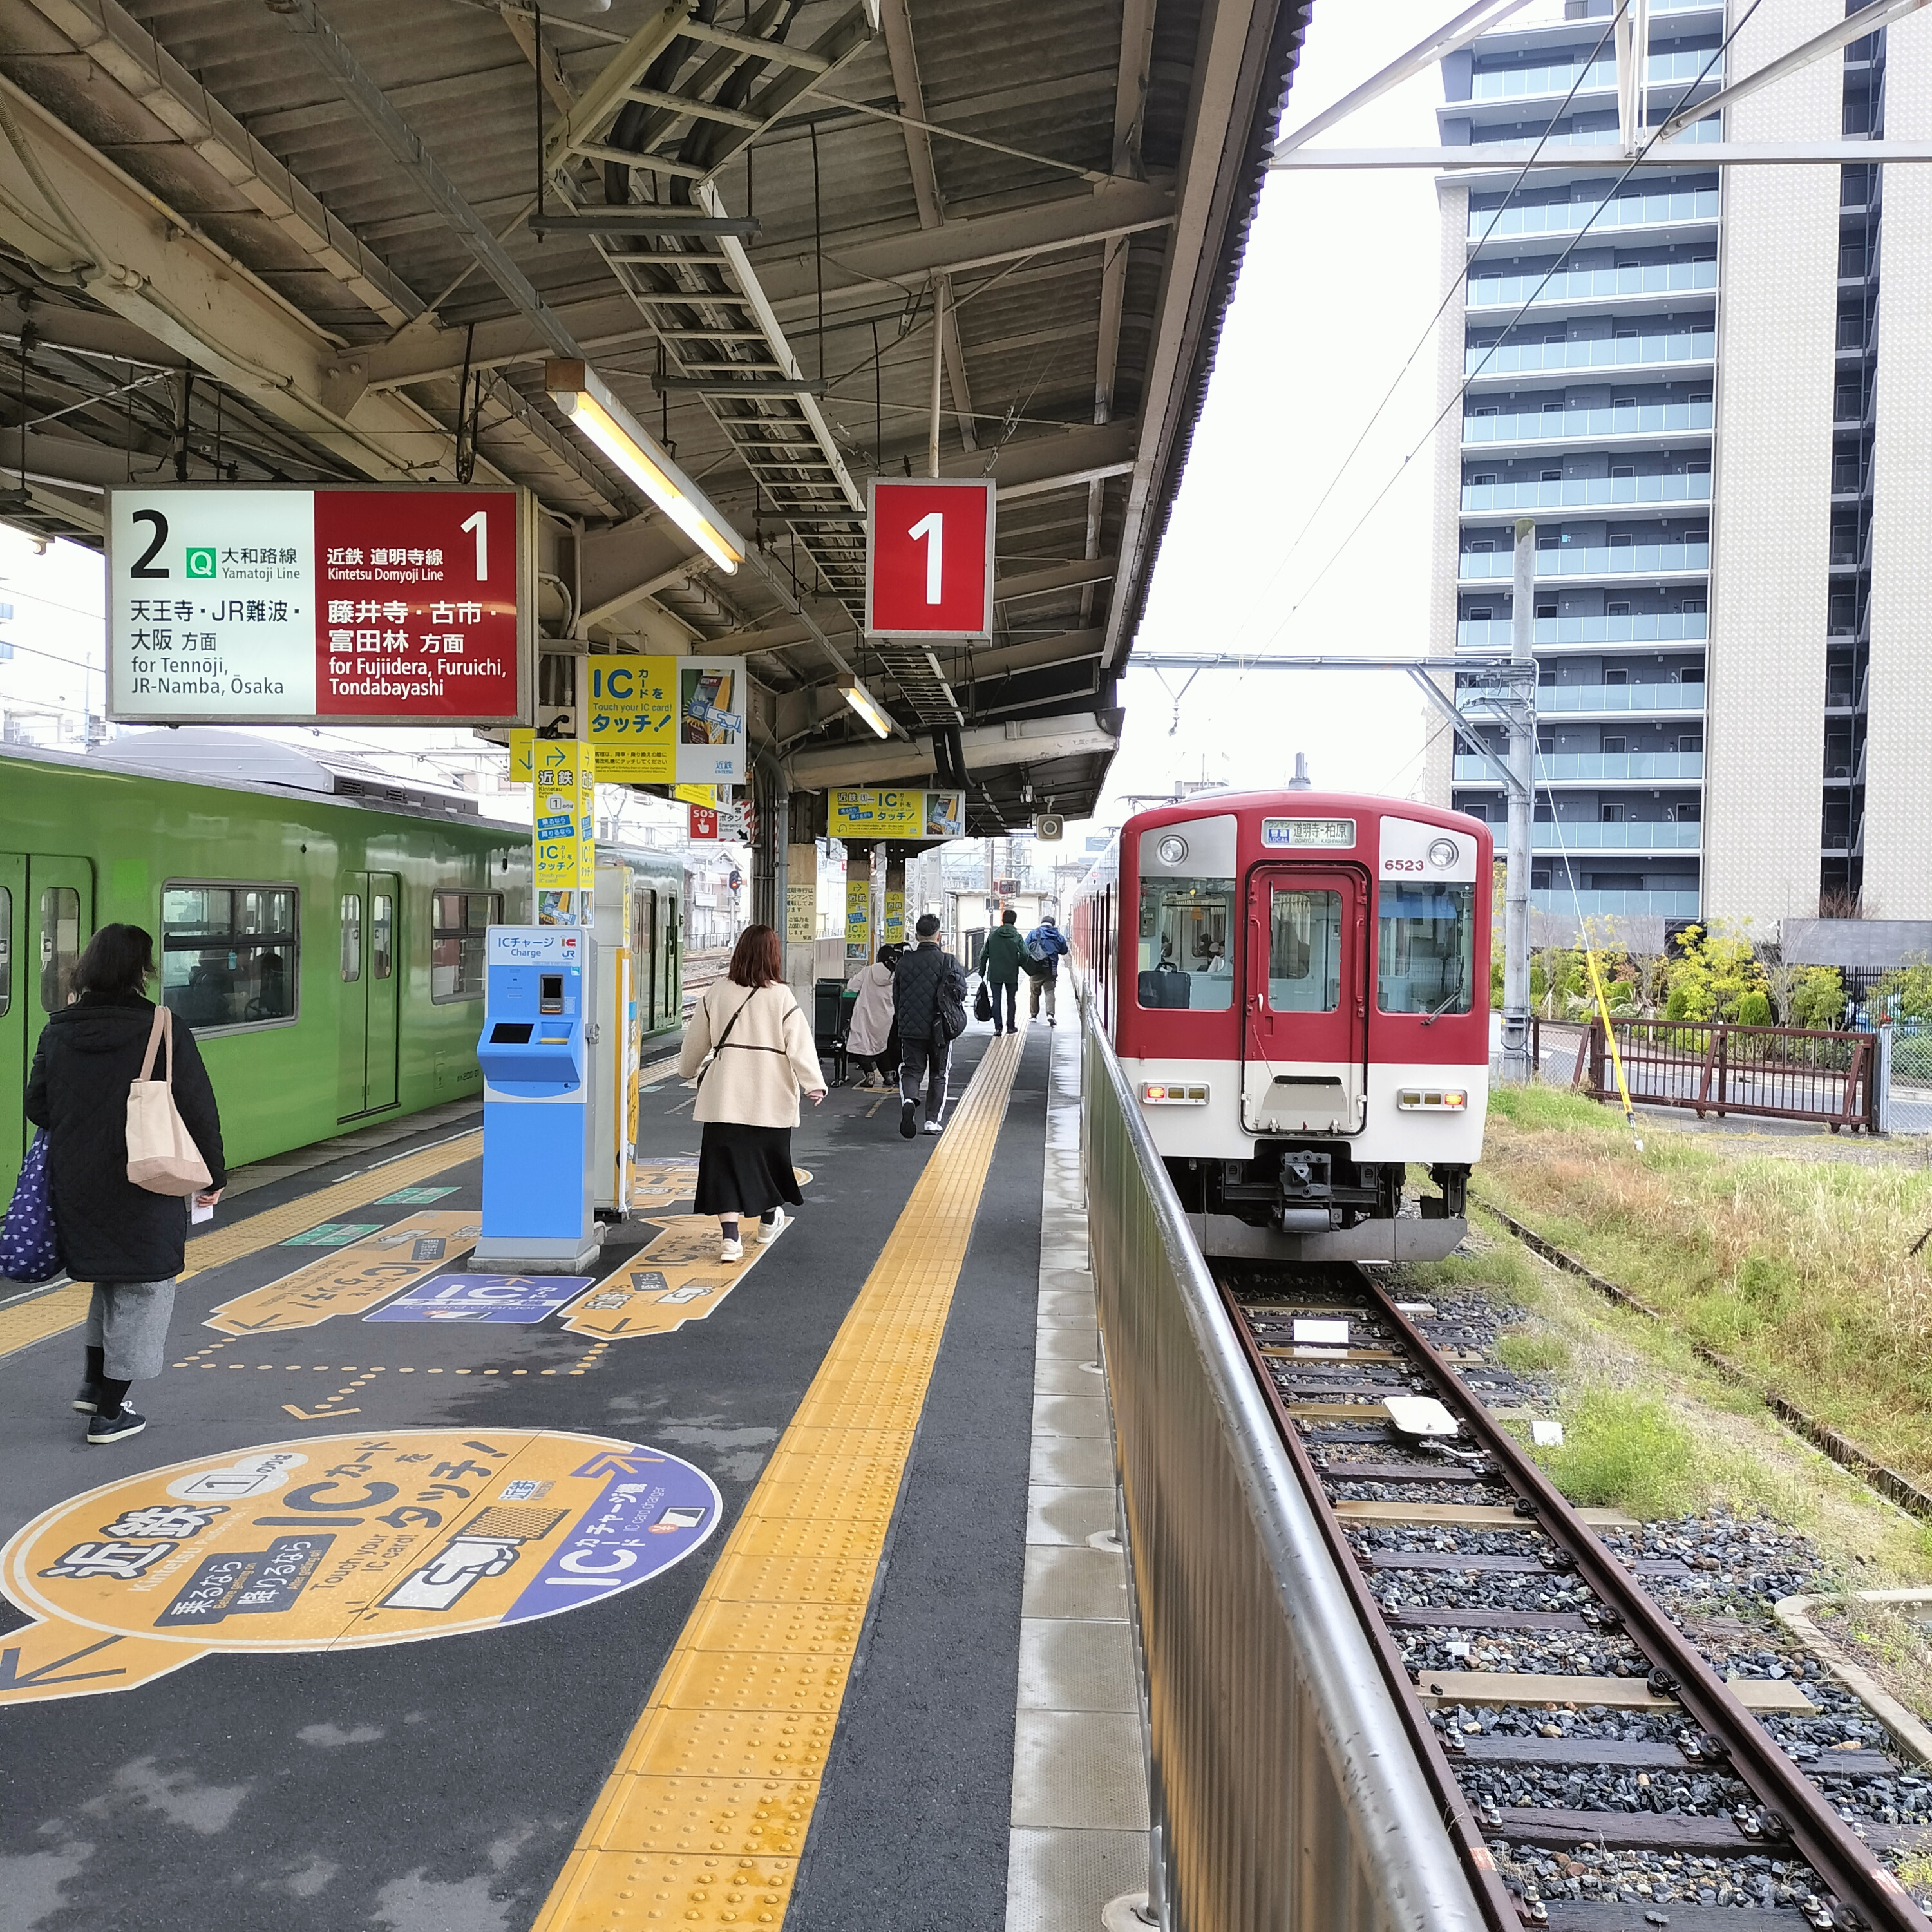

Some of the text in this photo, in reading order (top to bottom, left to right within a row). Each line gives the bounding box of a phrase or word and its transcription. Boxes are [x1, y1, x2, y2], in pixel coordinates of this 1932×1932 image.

[131, 509, 170, 578] 2
[460, 511, 488, 581] 1
[190, 551, 213, 576] Q
[221, 547, 297, 564] 大和路線
[327, 548, 444, 565] 近鉄 道明寺線
[908, 513, 943, 604] 1
[222, 567, 300, 582] Yamatoji Line
[328, 568, 444, 583] Kintetsu Domyoji Line
[131, 629, 217, 651] 大阪 方面
[328, 629, 465, 653] 富田林 方面
[131, 656, 228, 677] for Tennōji,
[329, 656, 506, 678] for Fujiidera, Furuichi,
[131, 674, 283, 696] JR-Namba, Ōsaka
[329, 678, 444, 700] Tondabayashi
[593, 703, 618, 711] Touch
[621, 705, 639, 713] your
[651, 703, 672, 712] card!
[715, 761, 733, 769] 近鉄
[538, 770, 574, 786] 近鉄
[837, 792, 858, 802] 近鉄
[693, 810, 715, 818] SOS
[1385, 860, 1424, 871] 6523
[498, 937, 555, 948] ICチャージ
[511, 948, 542, 958] Charge
[500, 1480, 541, 1500] 近鉄
[641, 1486, 667, 1509] charger
[37, 1504, 231, 1580] 近鉄
[361, 1533, 419, 1571] IC card!
[127, 1548, 203, 1591] Kintetsu
[237, 1541, 312, 1605] 降りるなら
[294, 1556, 322, 1577] getting
[309, 1533, 389, 1591] Touch your
[171, 1562, 242, 1615] 乗るなら
[211, 1590, 239, 1609] Before
[226, 1569, 256, 1591] getting
[285, 1575, 307, 1591] After
